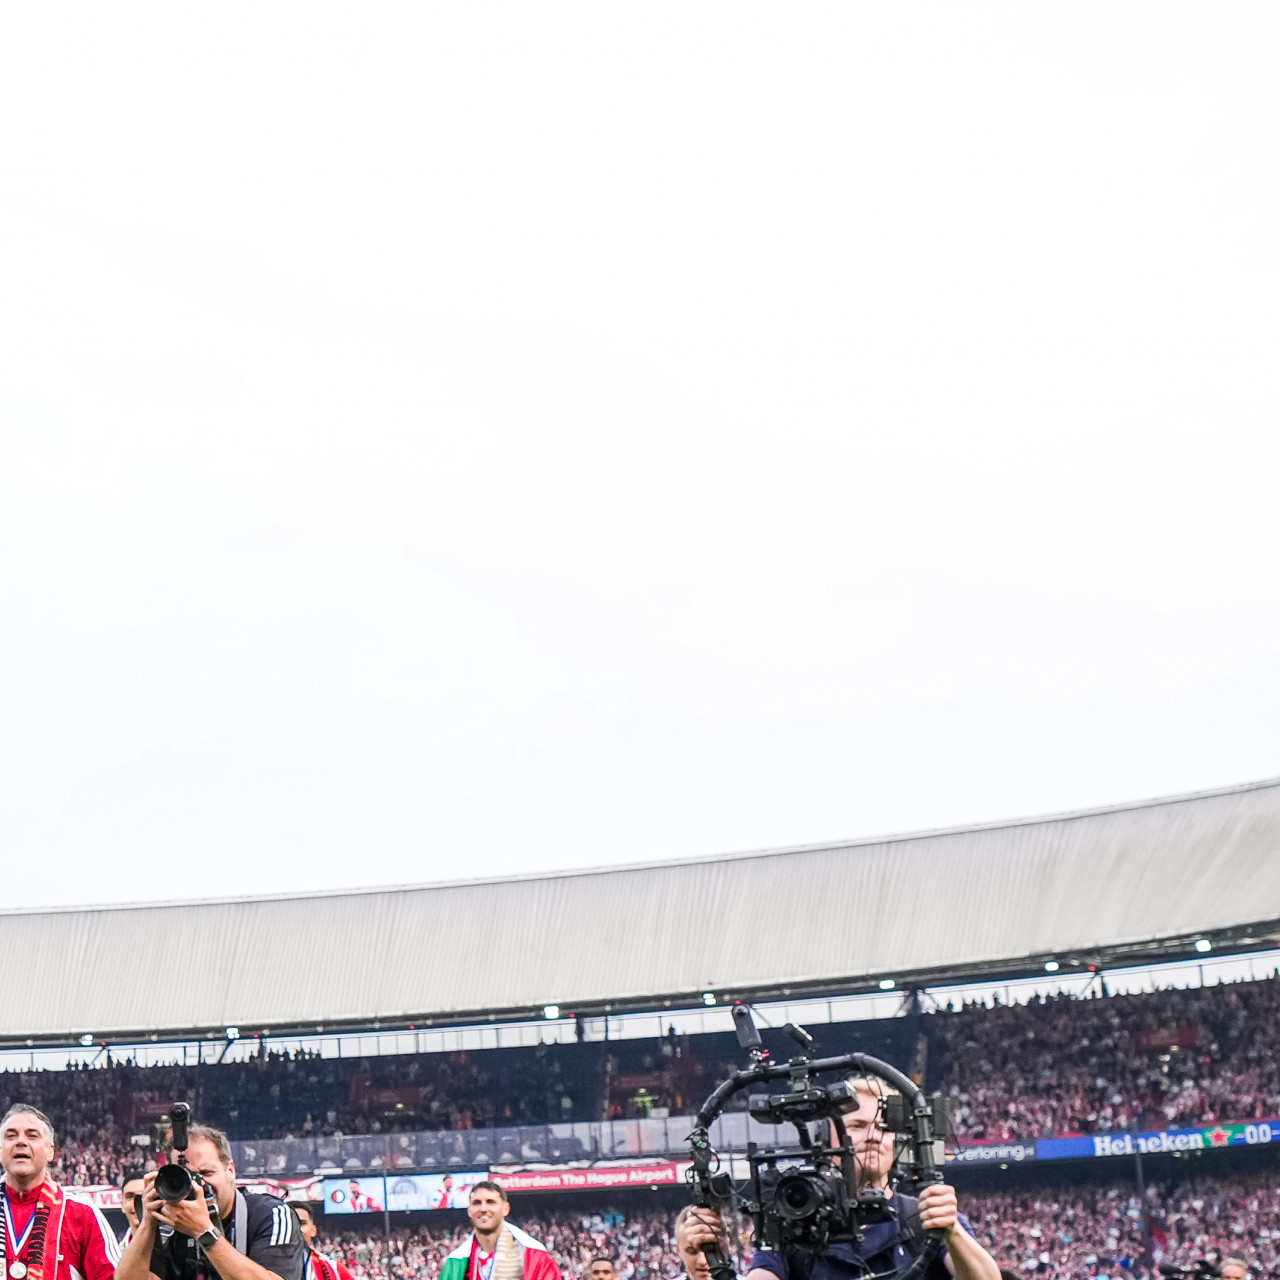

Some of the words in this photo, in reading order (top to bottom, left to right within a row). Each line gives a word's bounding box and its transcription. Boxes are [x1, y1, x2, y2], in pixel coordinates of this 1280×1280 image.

[1094, 1132, 1204, 1157] Heineken
[493, 1174, 561, 1188] Rotterdam
[561, 1173, 586, 1185] The
[586, 1171, 628, 1186] Hague
[629, 1168, 675, 1183] Airport
